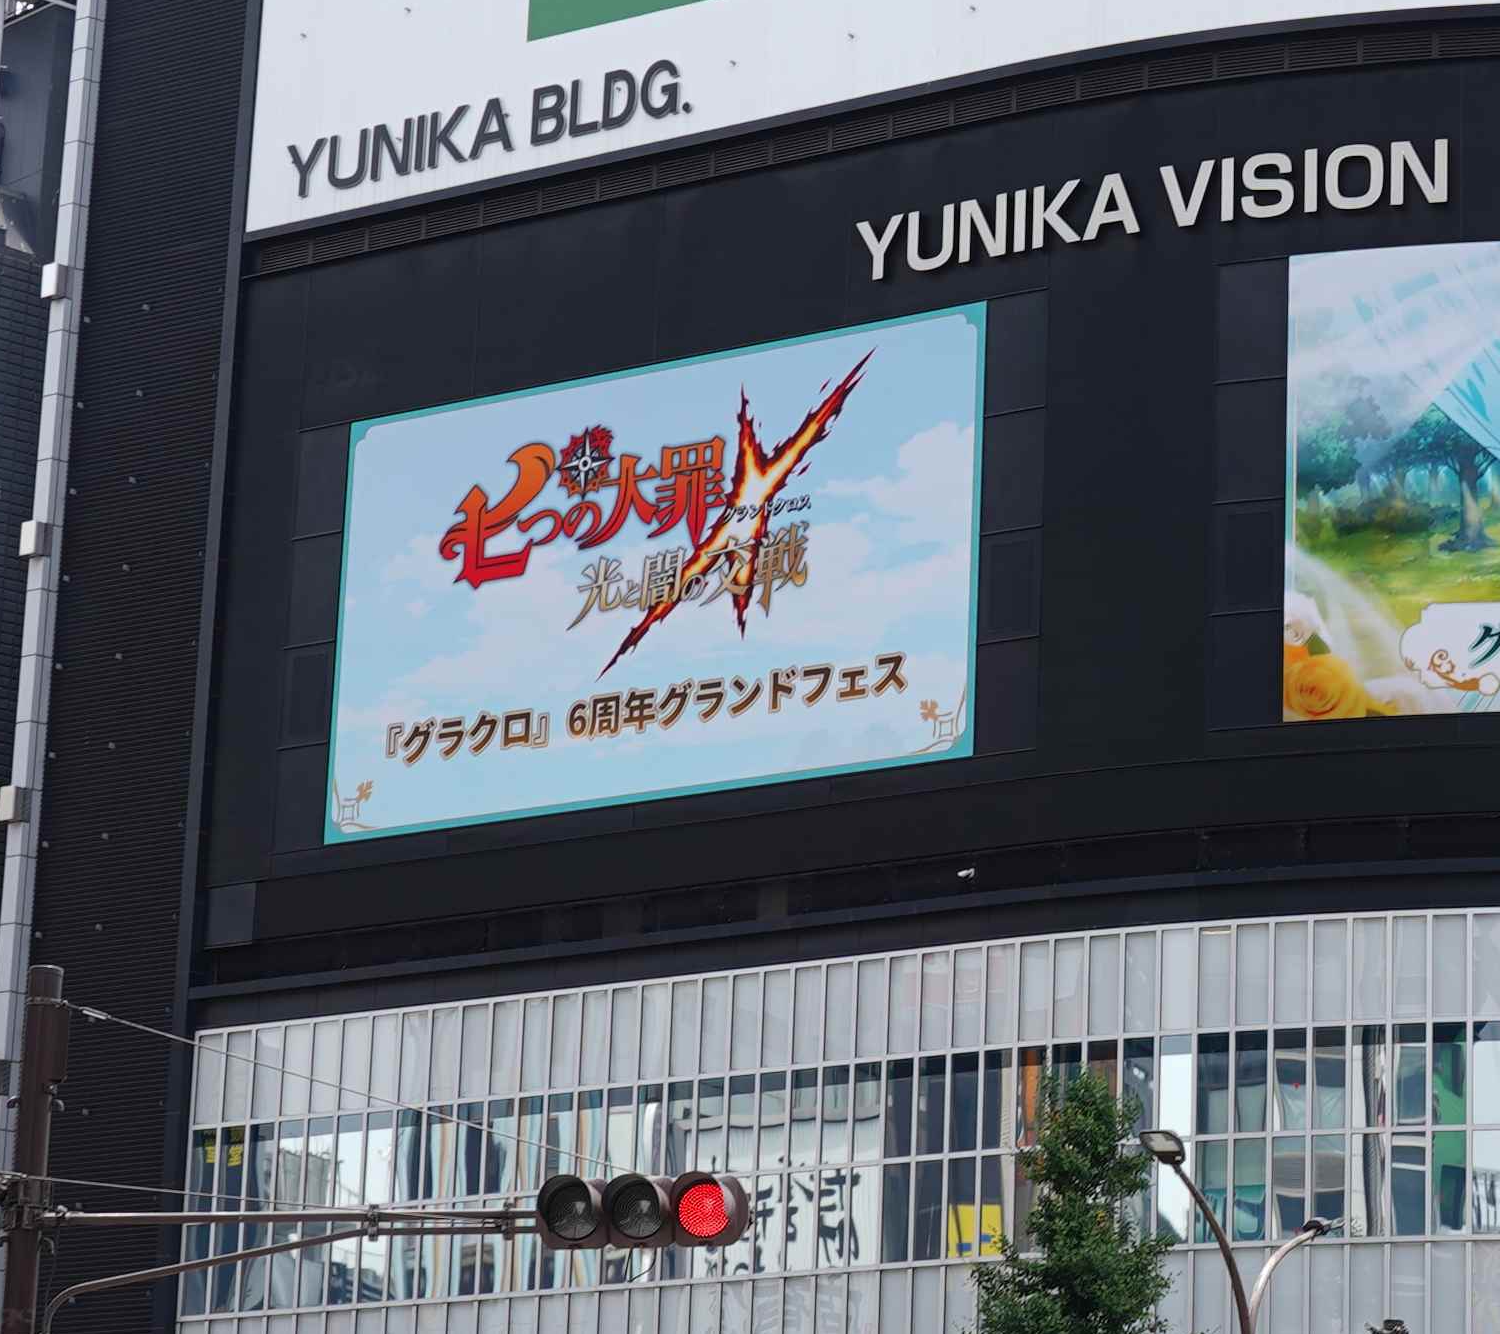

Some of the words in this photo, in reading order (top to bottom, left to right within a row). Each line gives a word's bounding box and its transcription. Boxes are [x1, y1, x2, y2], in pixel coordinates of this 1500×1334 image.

[286, 96, 512, 200] YUNIKA
[529, 58, 693, 148] BLDG.
[856, 171, 1141, 282] YUNIKA
[1159, 138, 1451, 229] VISION
